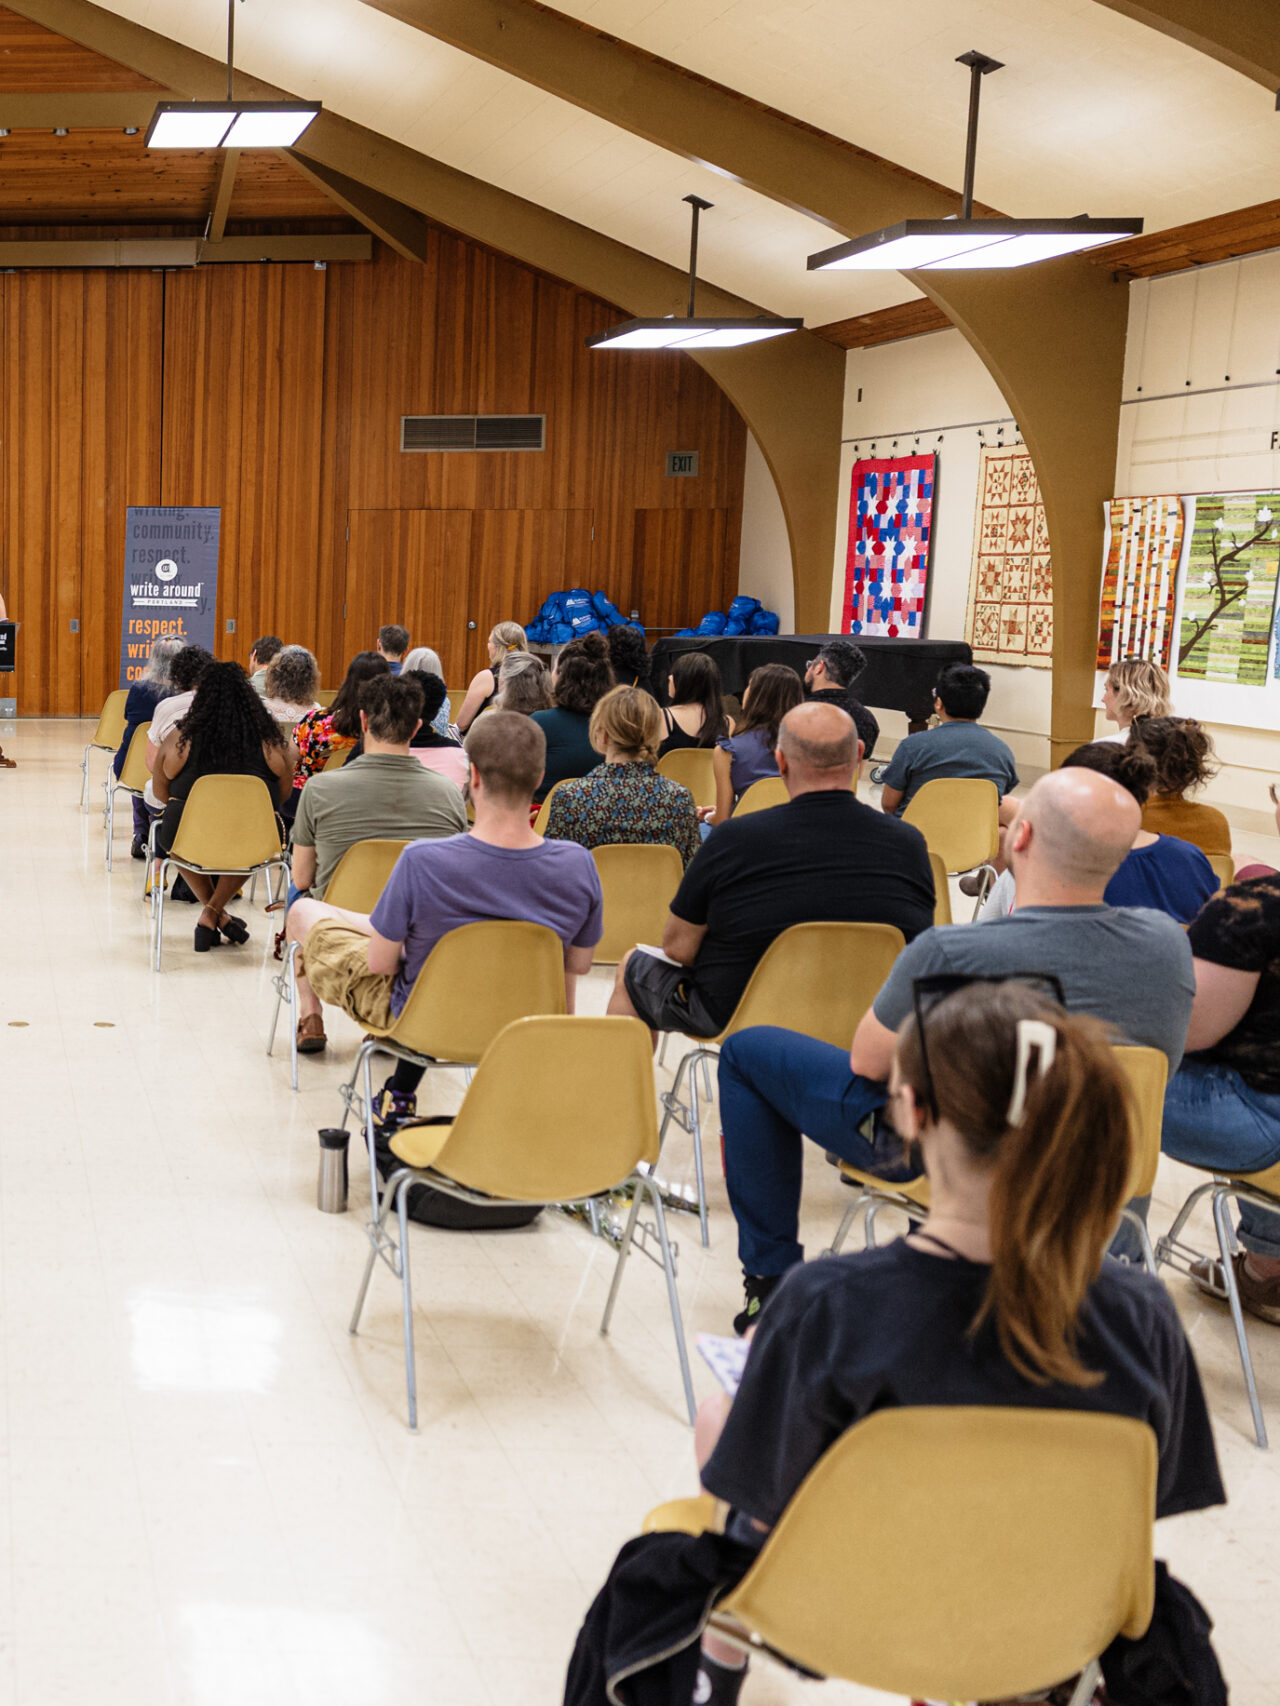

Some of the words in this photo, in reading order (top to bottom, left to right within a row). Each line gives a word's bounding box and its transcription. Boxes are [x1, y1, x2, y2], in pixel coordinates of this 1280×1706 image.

[1270, 431, 1280, 450] F
[672, 456, 693, 472] EXIT
[133, 521, 214, 544] community.
[130, 581, 159, 597] write
[162, 582, 201, 598] around
[129, 617, 187, 639] respect.
